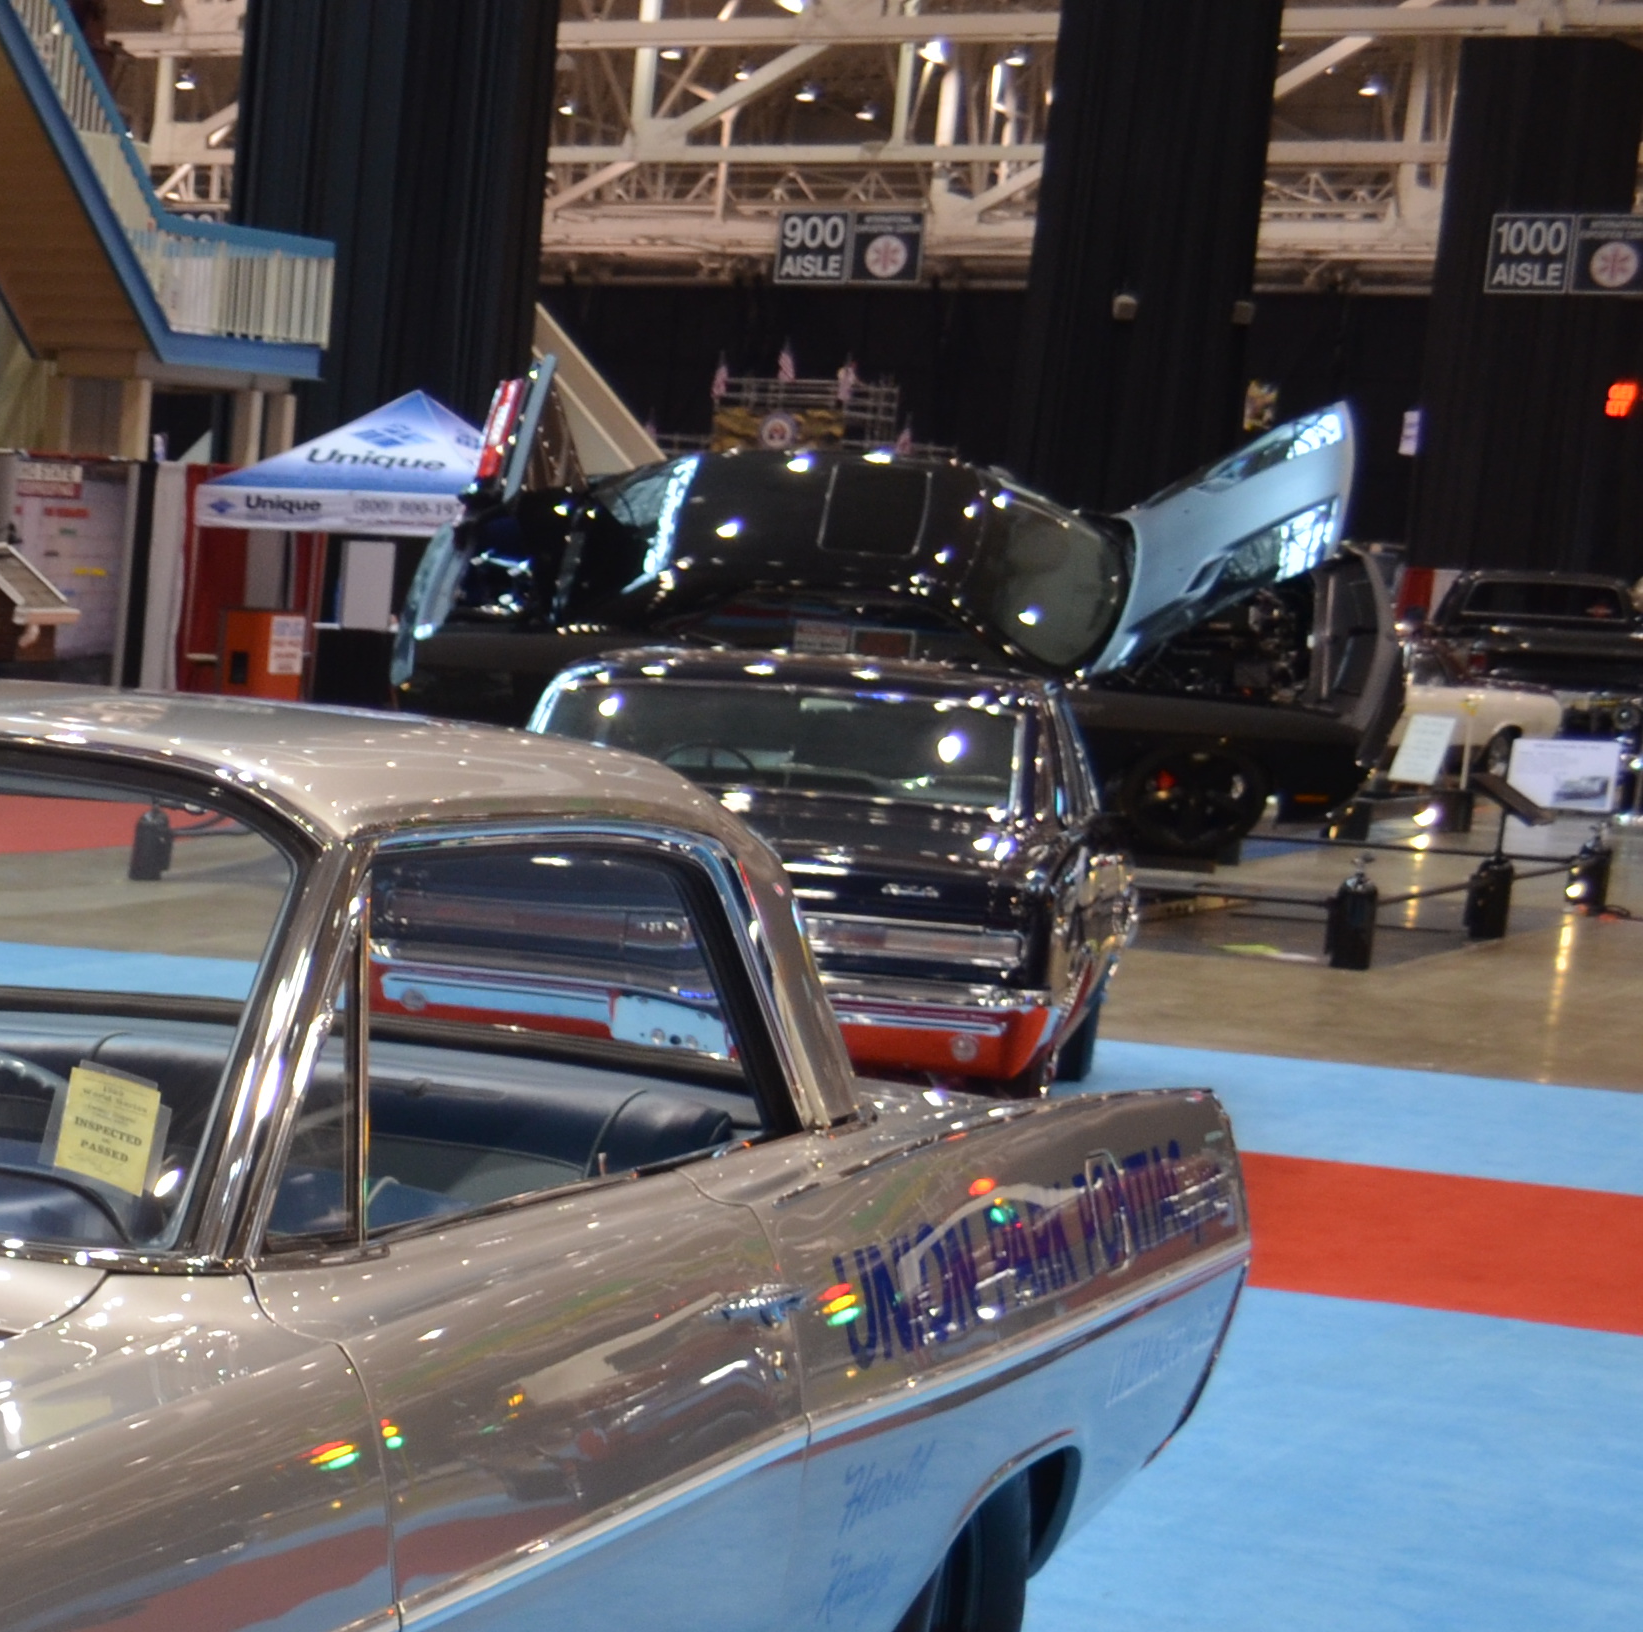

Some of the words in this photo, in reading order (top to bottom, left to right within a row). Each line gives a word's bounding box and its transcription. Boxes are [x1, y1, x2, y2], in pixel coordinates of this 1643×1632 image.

[783, 216, 845, 248] 900
[1497, 221, 1568, 255] 1000
[780, 255, 842, 277] AISLE
[1492, 262, 1563, 286] AISLE
[307, 448, 446, 472] Unique
[244, 494, 322, 514] Unique
[74, 1116, 142, 1147] INSPECTED
[80, 1139, 129, 1163] PASSED
